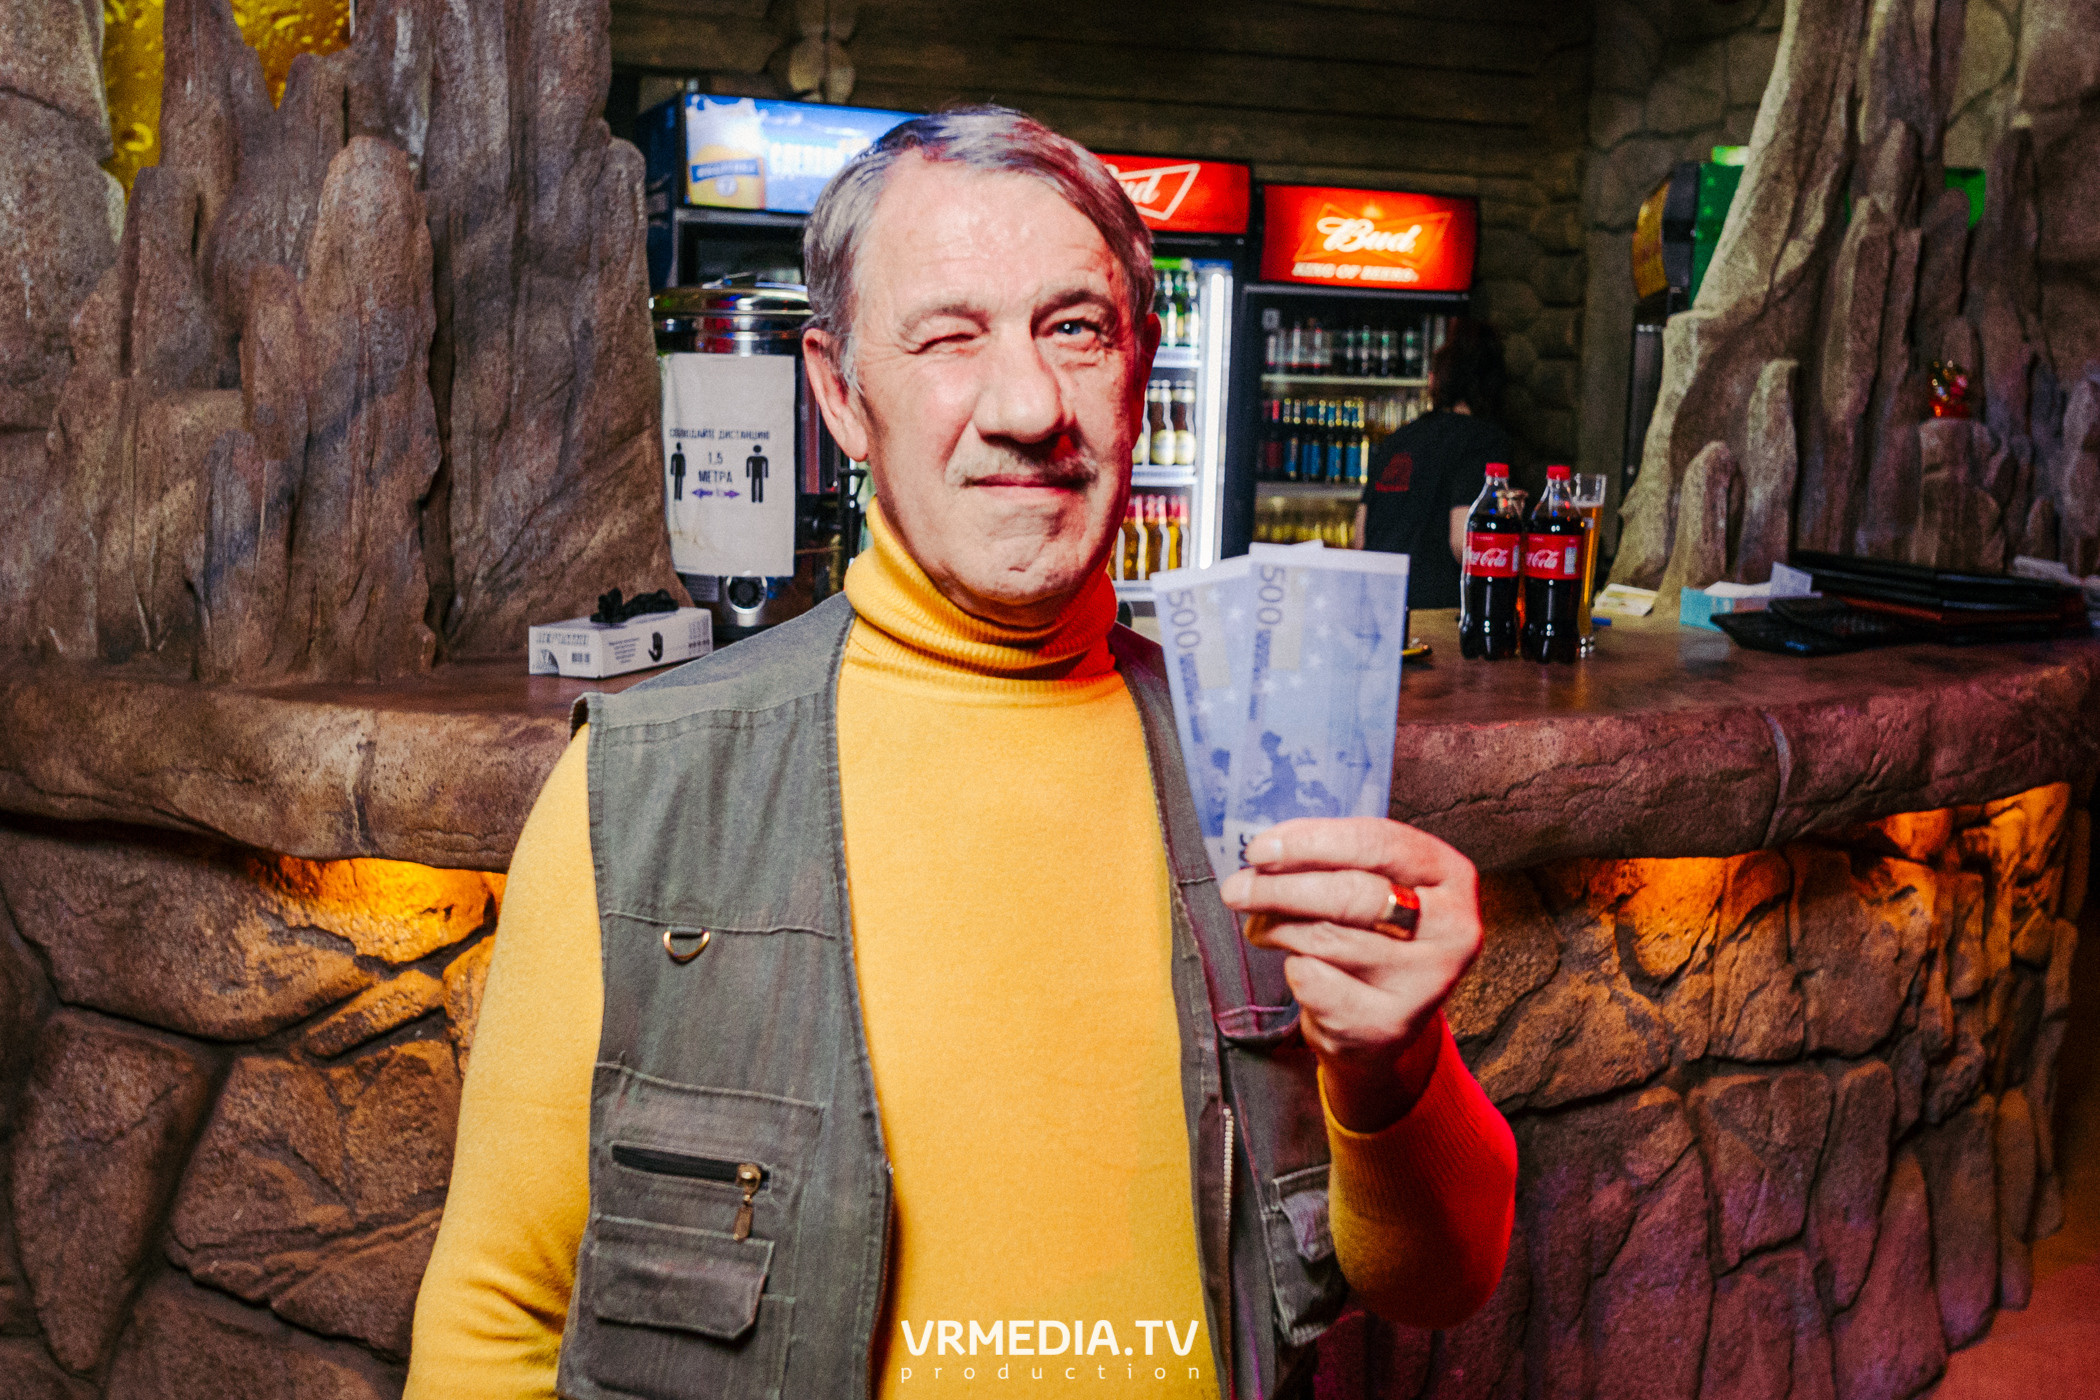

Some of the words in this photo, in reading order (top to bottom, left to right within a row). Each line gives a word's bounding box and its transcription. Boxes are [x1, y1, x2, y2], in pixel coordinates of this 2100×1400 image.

[1104, 164, 1161, 204] ud
[1316, 216, 1422, 253] Bud
[698, 470, 732, 483] МЕТРА
[1257, 565, 1286, 626] 500
[1168, 589, 1200, 649] 500
